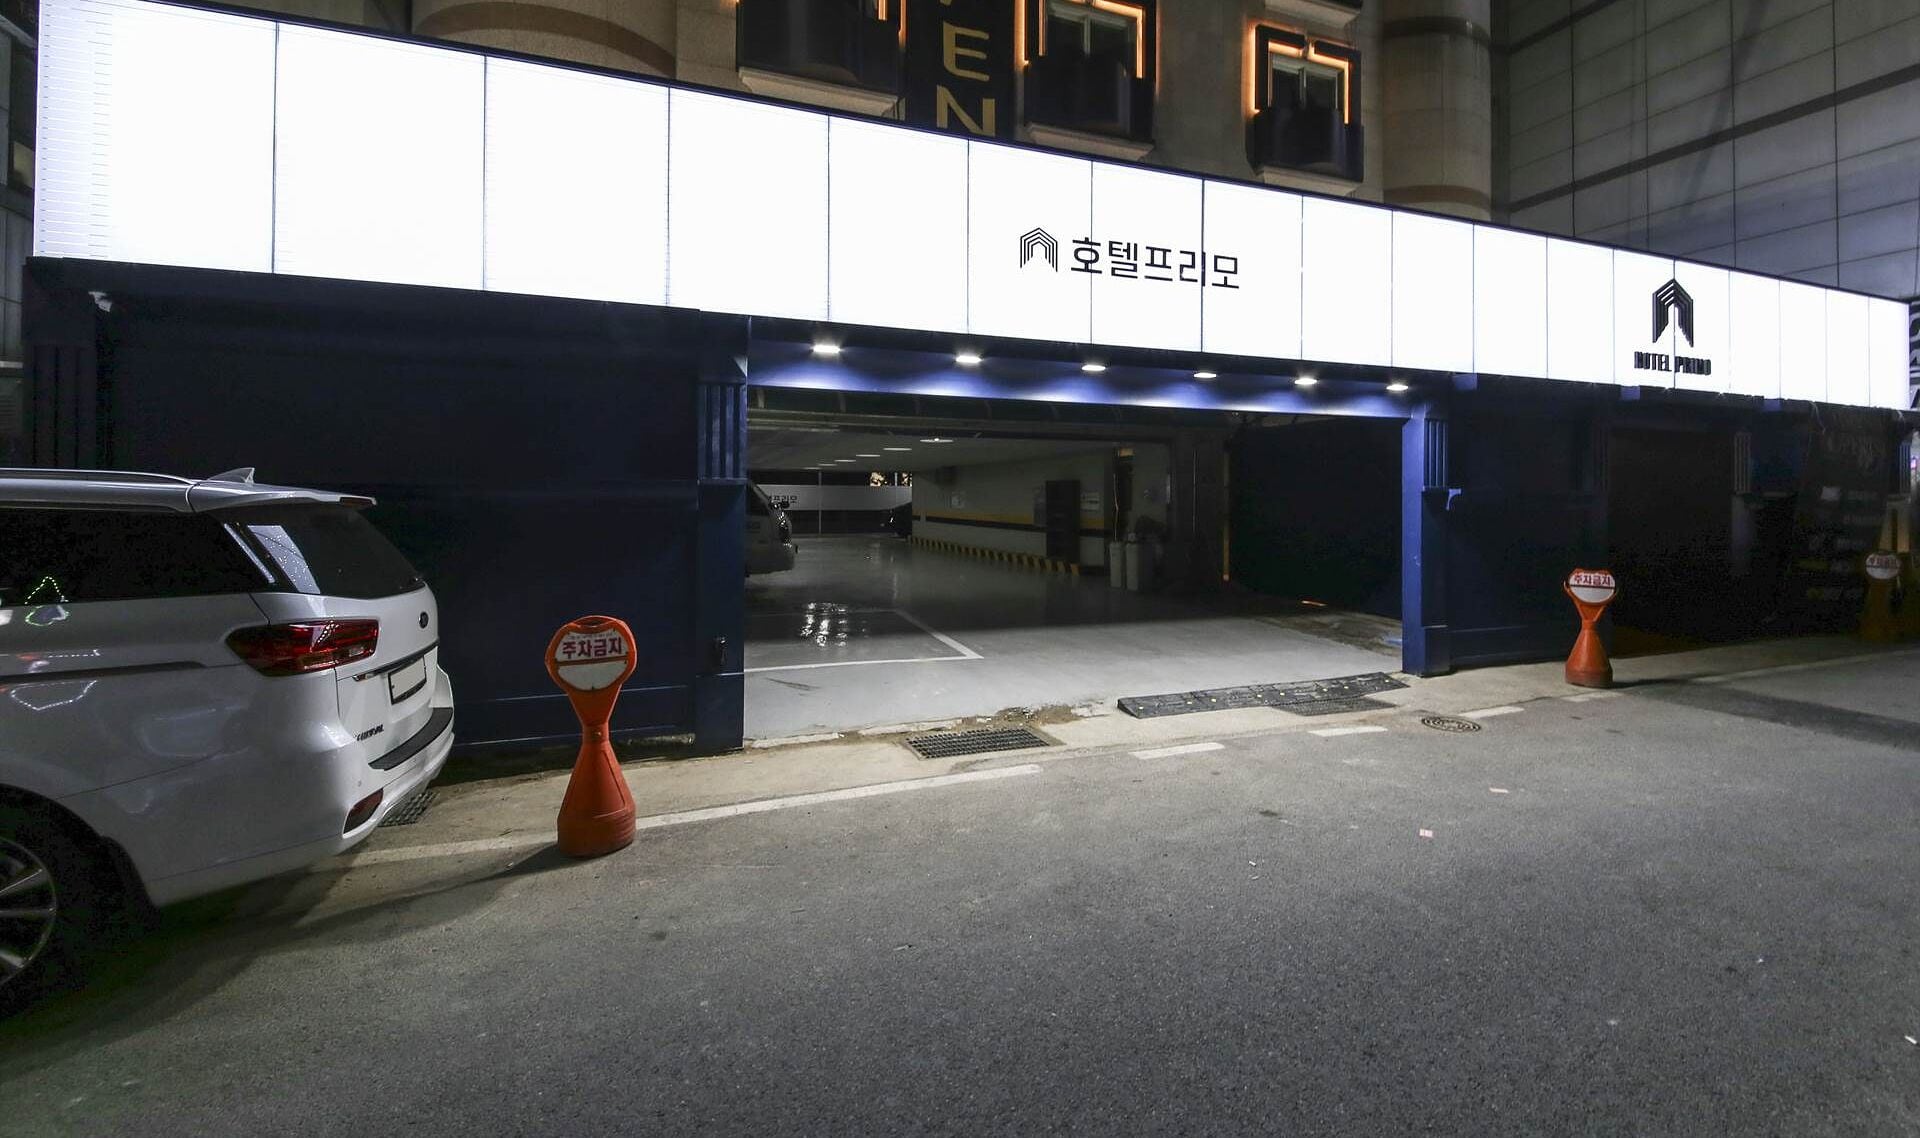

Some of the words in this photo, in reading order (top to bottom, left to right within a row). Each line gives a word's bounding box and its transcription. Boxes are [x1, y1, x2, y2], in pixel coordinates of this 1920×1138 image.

[937, 0, 996, 137] EN
[1071, 237, 1239, 289] 호텔프리모
[1634, 351, 1672, 372] HOTEL
[1674, 356, 1711, 376] PRIMO
[562, 637, 622, 658] 주차금지
